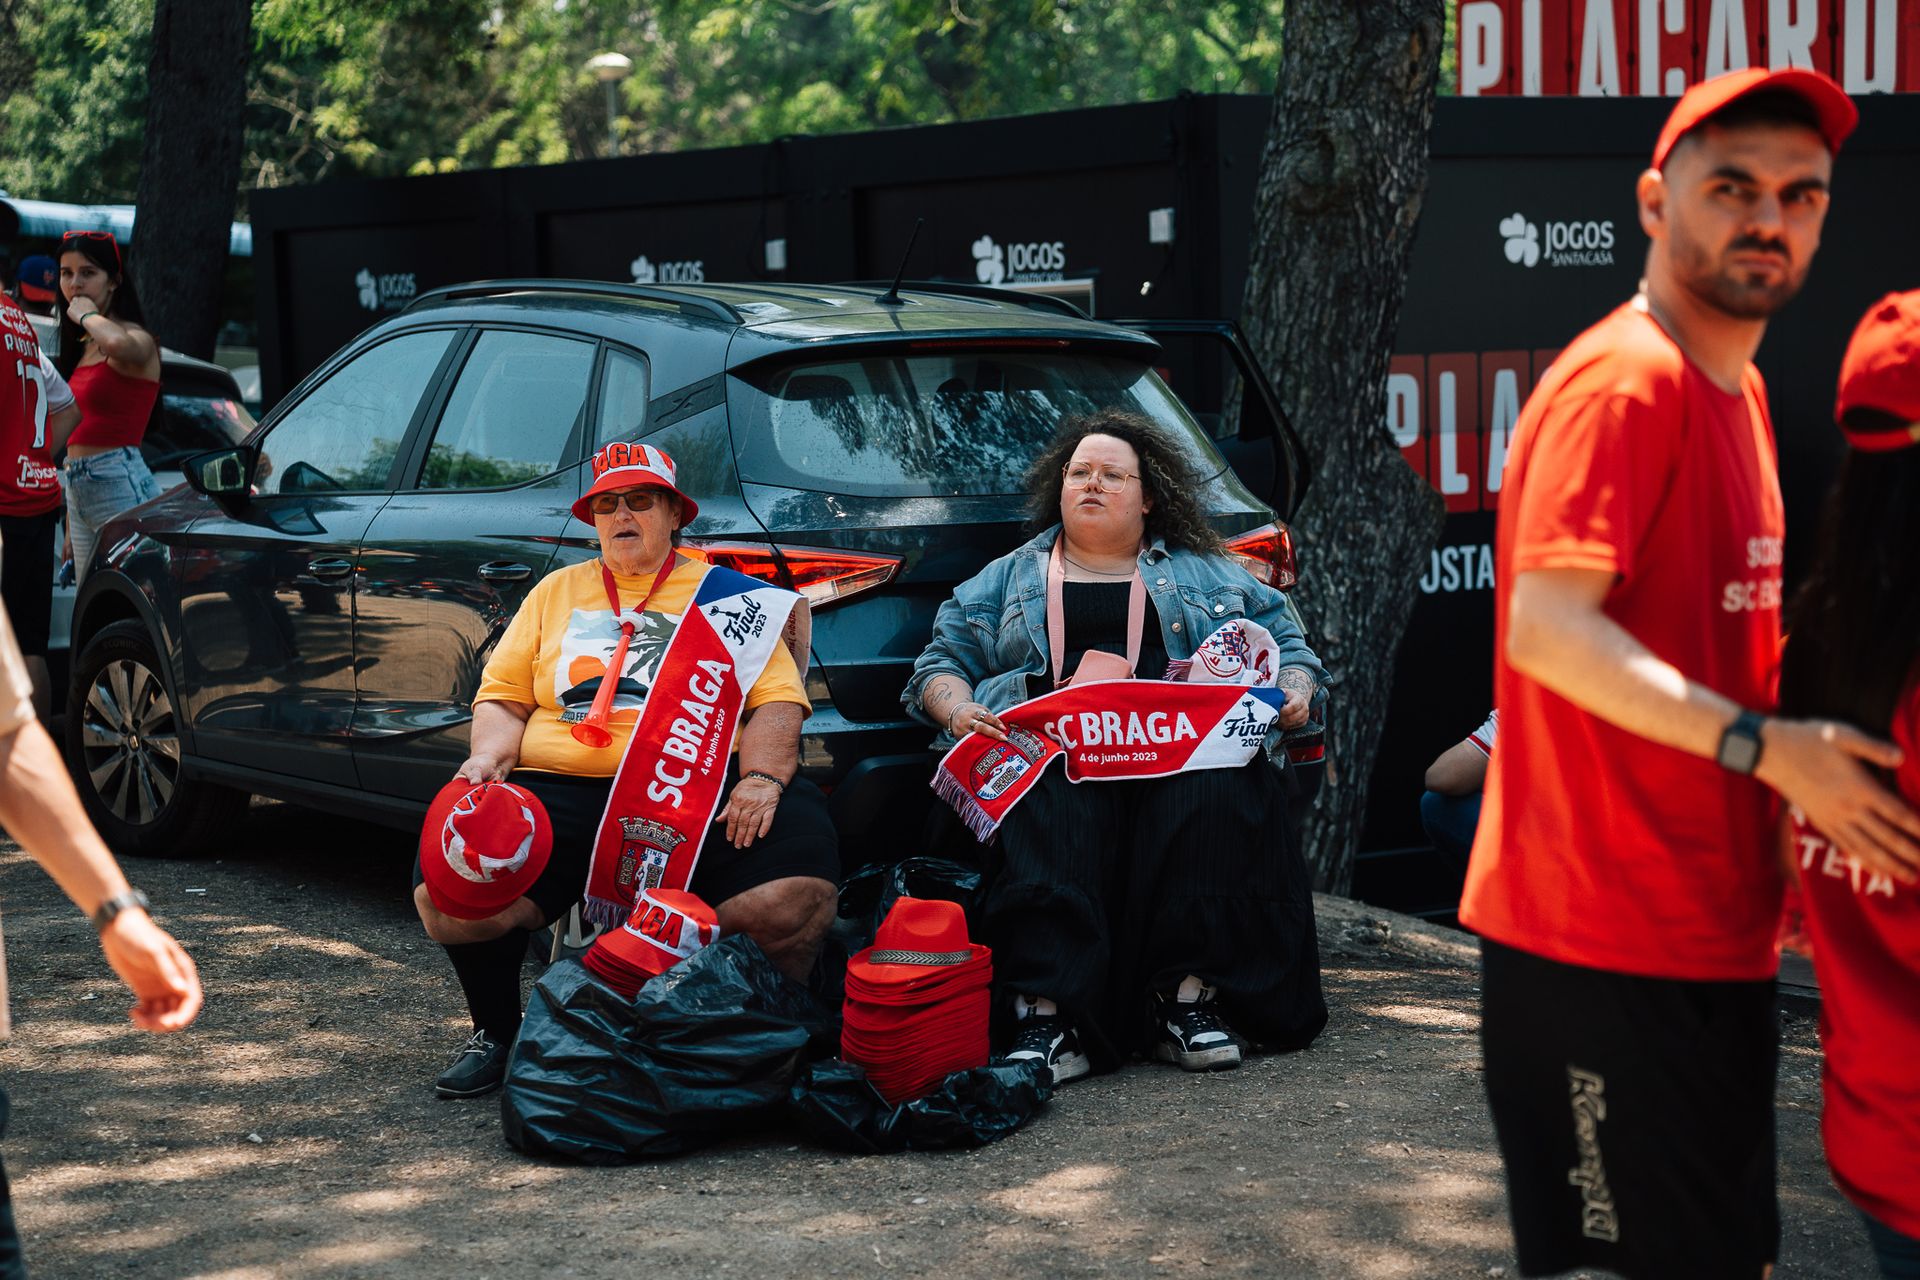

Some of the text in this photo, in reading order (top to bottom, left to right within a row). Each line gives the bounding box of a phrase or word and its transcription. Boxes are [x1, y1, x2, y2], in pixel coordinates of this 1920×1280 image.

[1544, 221, 1615, 259] JOGOS
[1007, 241, 1065, 279] JOGOS
[723, 595, 761, 646] Final
[752, 613, 767, 638] 2023
[647, 659, 731, 809] SC BRAGA
[701, 708, 726, 776] 4 de junho 2023
[1079, 711, 1198, 746] BRAGA
[1080, 752, 1158, 765] 4 de junho 2023
